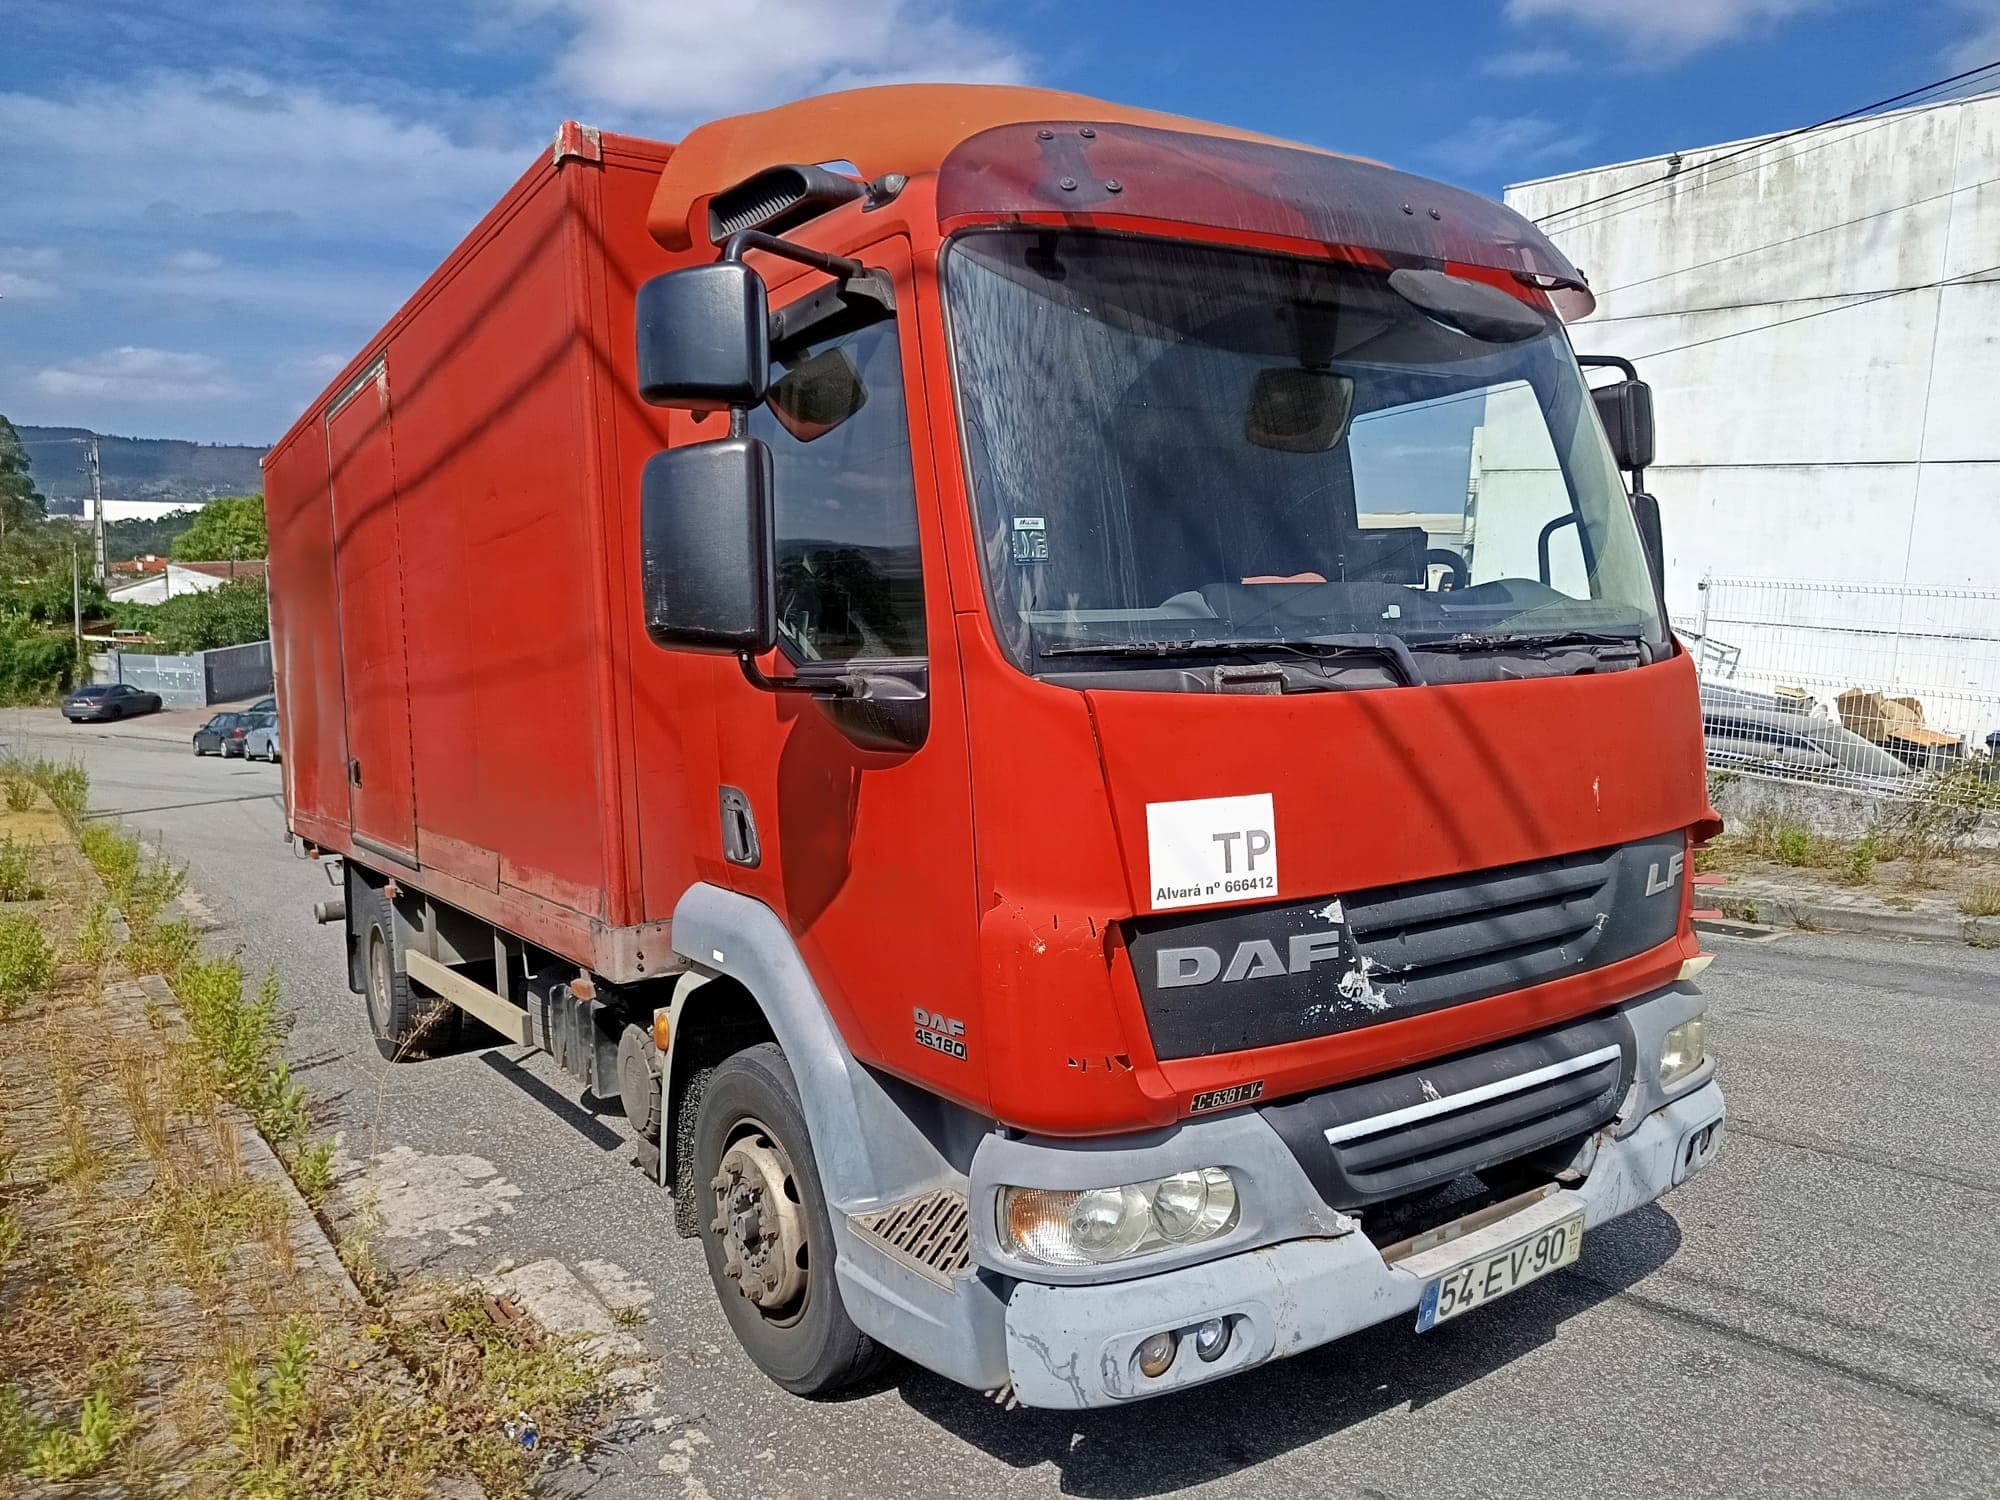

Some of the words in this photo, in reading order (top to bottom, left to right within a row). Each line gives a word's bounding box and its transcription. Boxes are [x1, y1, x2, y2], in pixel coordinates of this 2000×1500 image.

[1212, 829, 1271, 873] TP
[1156, 883, 1201, 901] Alvará
[1224, 876, 1274, 893] 666412
[1645, 851, 1684, 897] LF
[1156, 930, 1340, 989] DAF
[913, 1006, 966, 1038] DAF
[1425, 1309, 1432, 1321] P
